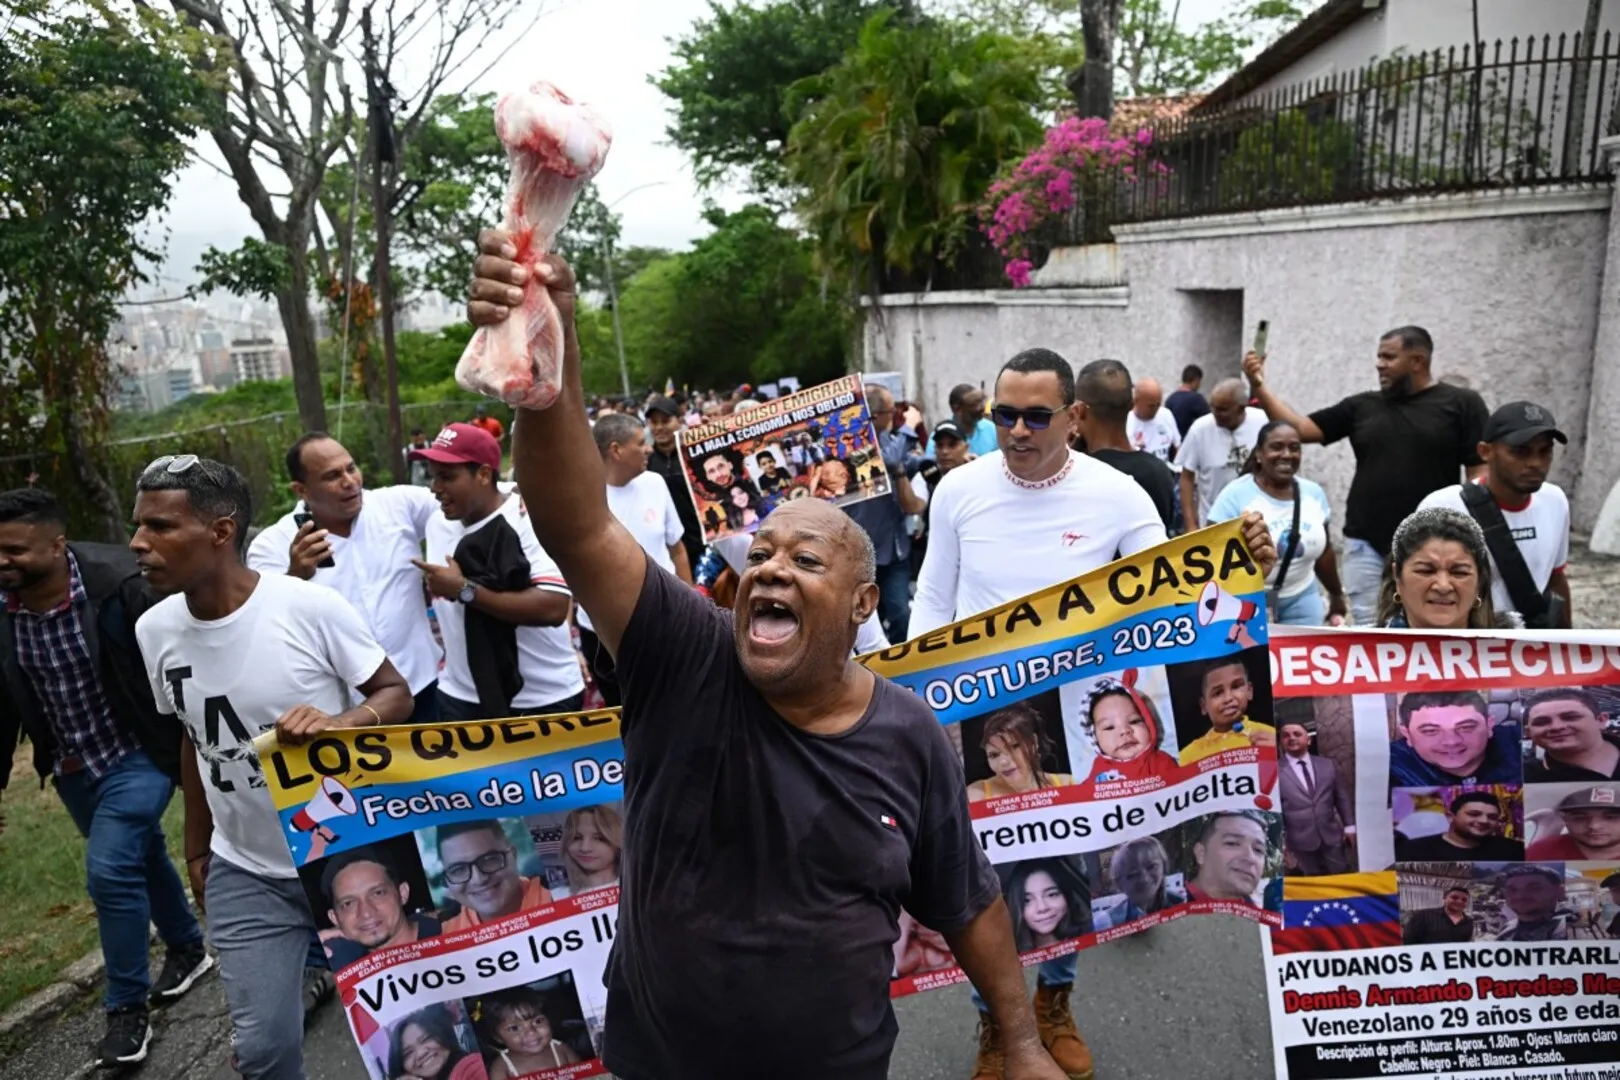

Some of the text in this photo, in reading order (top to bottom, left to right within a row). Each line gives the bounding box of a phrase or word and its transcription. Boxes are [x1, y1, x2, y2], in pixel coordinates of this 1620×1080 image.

[683, 377, 855, 446] NADIE QUISO EMIGRAR
[688, 444, 704, 457] LA
[704, 432, 737, 452] MALA
[792, 406, 815, 423] NOS
[861, 537, 1257, 664] UELTA A CASA
[924, 615, 1197, 710] OCTUBRE, 2023
[271, 733, 392, 789] LOS
[362, 758, 625, 826] Fecha de la De
[1022, 790, 1060, 802] GUEVARA
[1030, 798, 1053, 807] AÑOS
[1093, 781, 1167, 800] GUEVARA MORENO
[1094, 776, 1162, 792] EDWIN EDUARDO
[979, 814, 1092, 850] remos
[1102, 804, 1146, 833] de
[529, 906, 555, 919] TORRES
[336, 959, 371, 983] ROSMER
[411, 939, 441, 951] PARRA
[358, 913, 618, 1012] Vivos se los ll
[397, 951, 421, 962] AÑOS
[946, 970, 957, 978] LA
[1278, 946, 1620, 987] ¡AYUDANOS A ENCONTRARL
[1283, 972, 1620, 1014] Dennis Armando Paredes Me
[1302, 1012, 1434, 1037] Venezolano
[1440, 1007, 1469, 1028] 29
[1476, 1005, 1532, 1026] años
[1538, 1001, 1568, 1022] de
[1316, 1044, 1375, 1061] Descripción
[1376, 1043, 1389, 1057] de
[1390, 1041, 1419, 1058] perfil:
[1420, 1038, 1453, 1054] Altura:
[1455, 1037, 1488, 1054] Aprox.
[1489, 1034, 1520, 1050] 1.80m
[1526, 1033, 1553, 1049] Ojos:
[1554, 1029, 1590, 1045] Marrón
[1592, 1028, 1618, 1042] claro
[1379, 1059, 1419, 1074] Cabello:
[1421, 1057, 1451, 1074] Negro
[1458, 1053, 1481, 1068] Piel:
[1482, 1051, 1518, 1067] Blanca
[1524, 1049, 1566, 1064] Casado.
[1564, 1068, 1597, 1080] futuro
